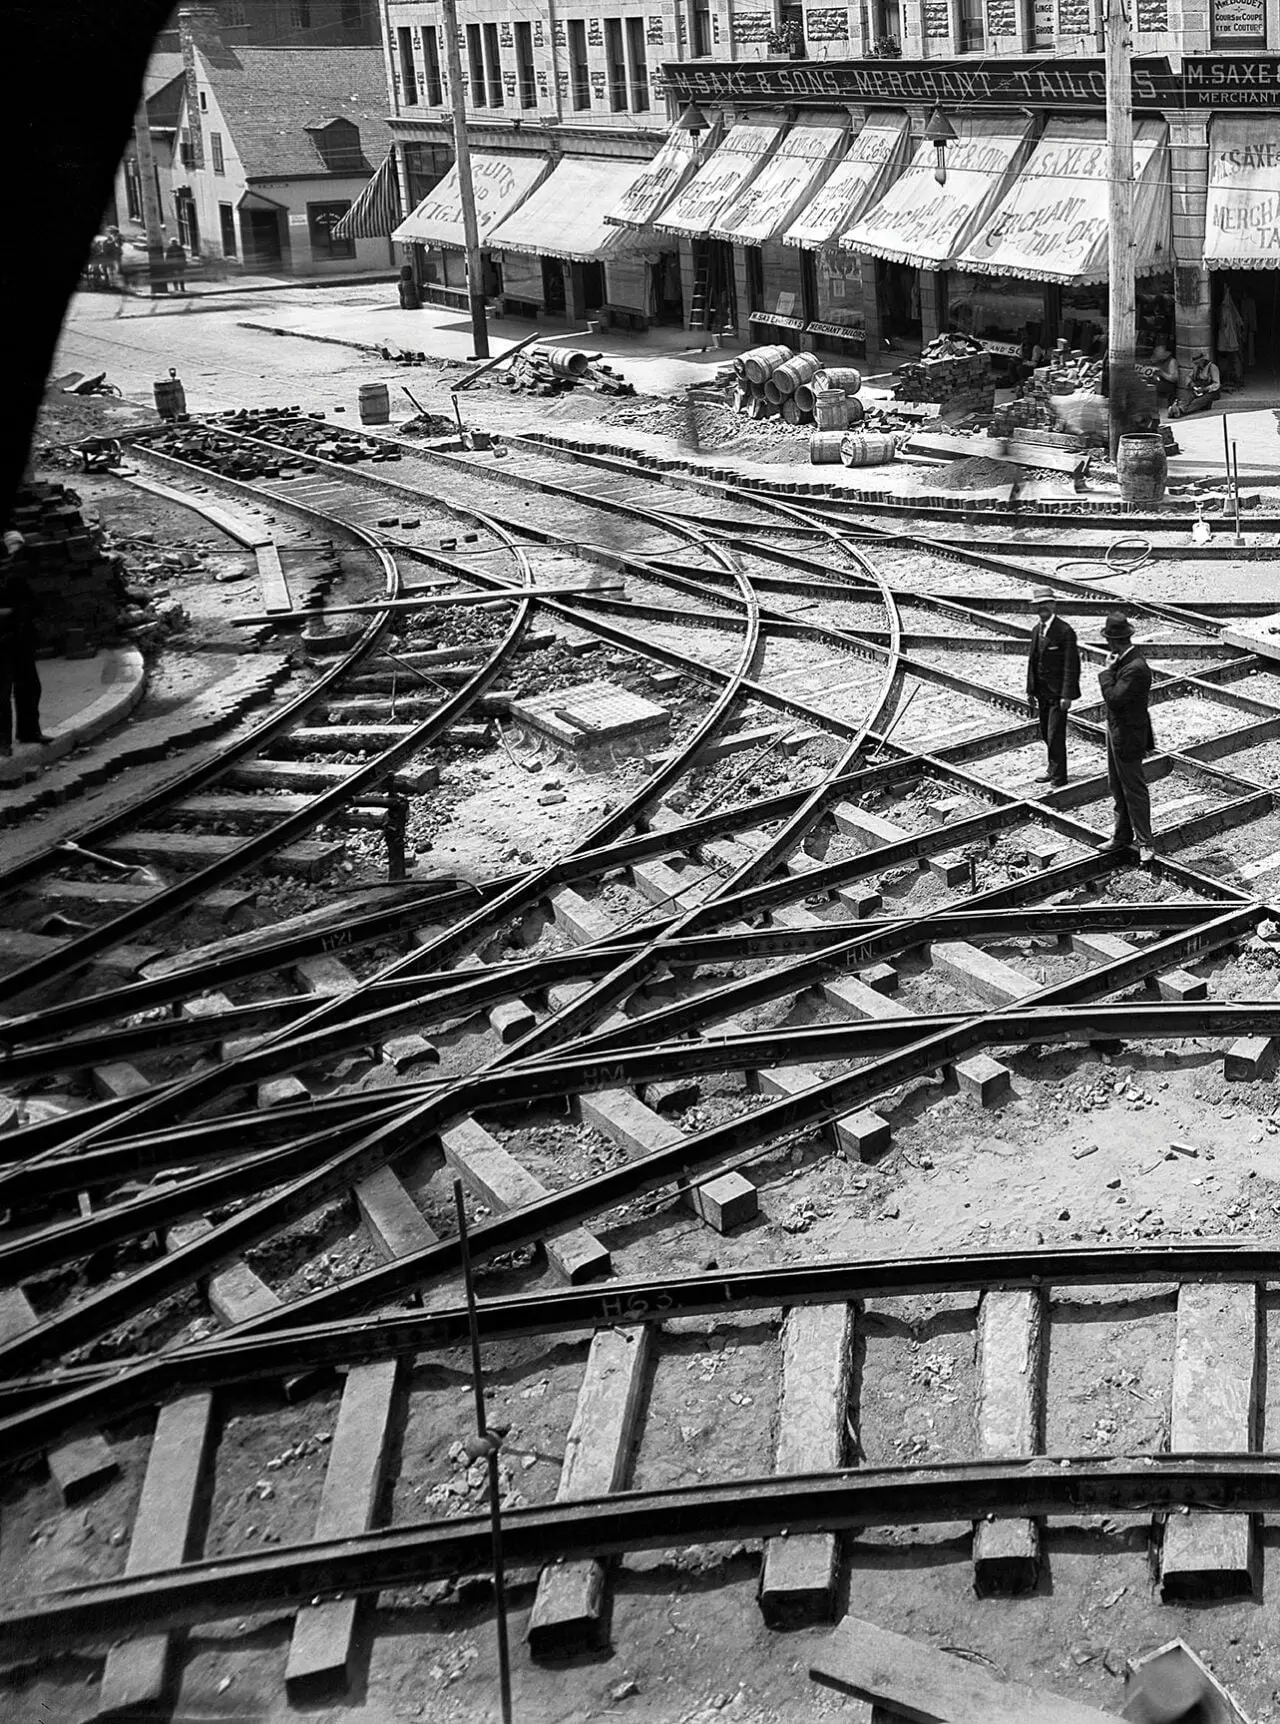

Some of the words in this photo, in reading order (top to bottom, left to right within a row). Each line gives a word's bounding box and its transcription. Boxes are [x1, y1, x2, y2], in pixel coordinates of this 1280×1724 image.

[695, 72, 753, 94] SAXE
[757, 71, 774, 94] &
[853, 71, 992, 97] MERCHANT
[1013, 70, 1167, 99] TAILOS.
[1211, 64, 1271, 84] SAXE
[1199, 91, 1280, 104] MERCHANT
[1229, 143, 1278, 172] SAXE
